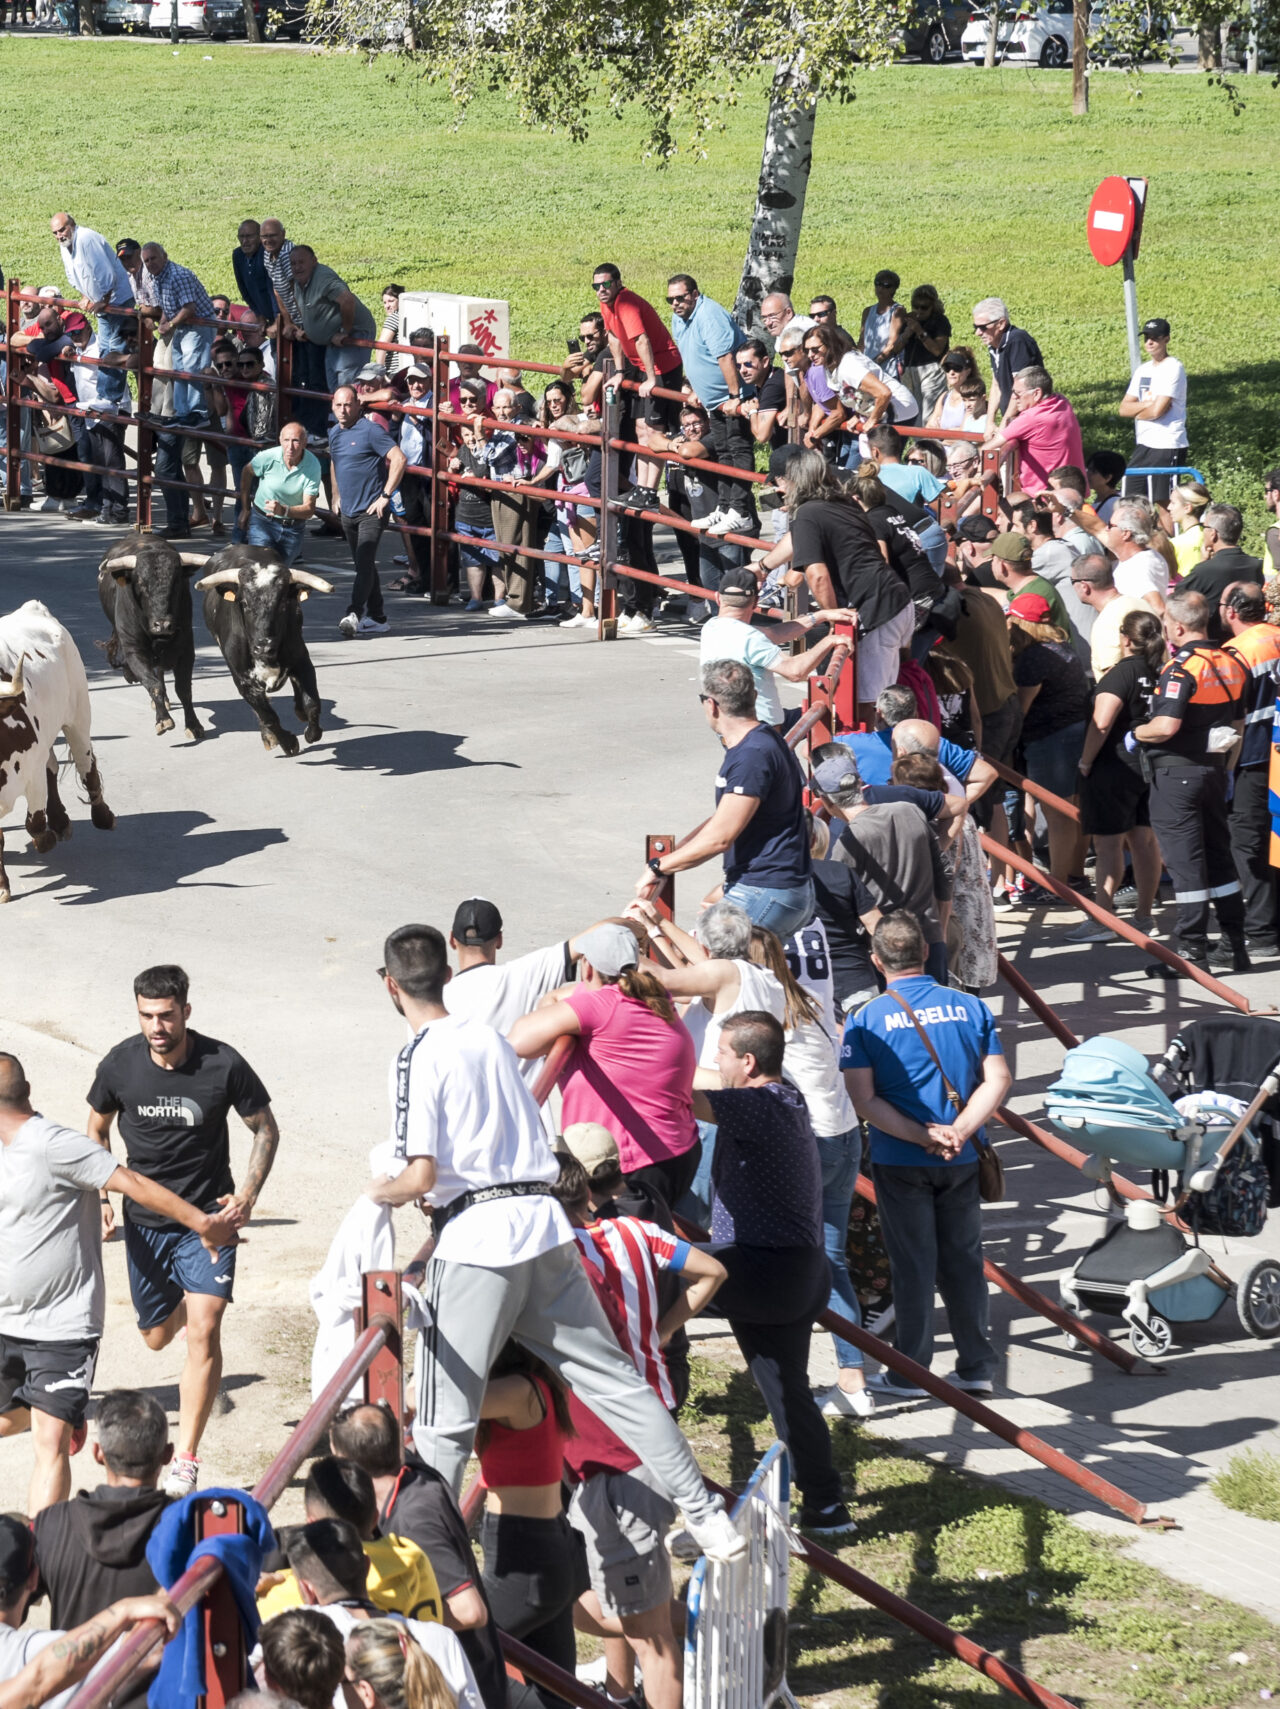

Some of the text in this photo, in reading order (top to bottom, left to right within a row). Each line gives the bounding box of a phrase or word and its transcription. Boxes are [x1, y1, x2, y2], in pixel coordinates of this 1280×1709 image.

[885, 1005, 969, 1031] MUGELLO
[156, 1095, 180, 1107] THE
[137, 1105, 181, 1117] NORTH
